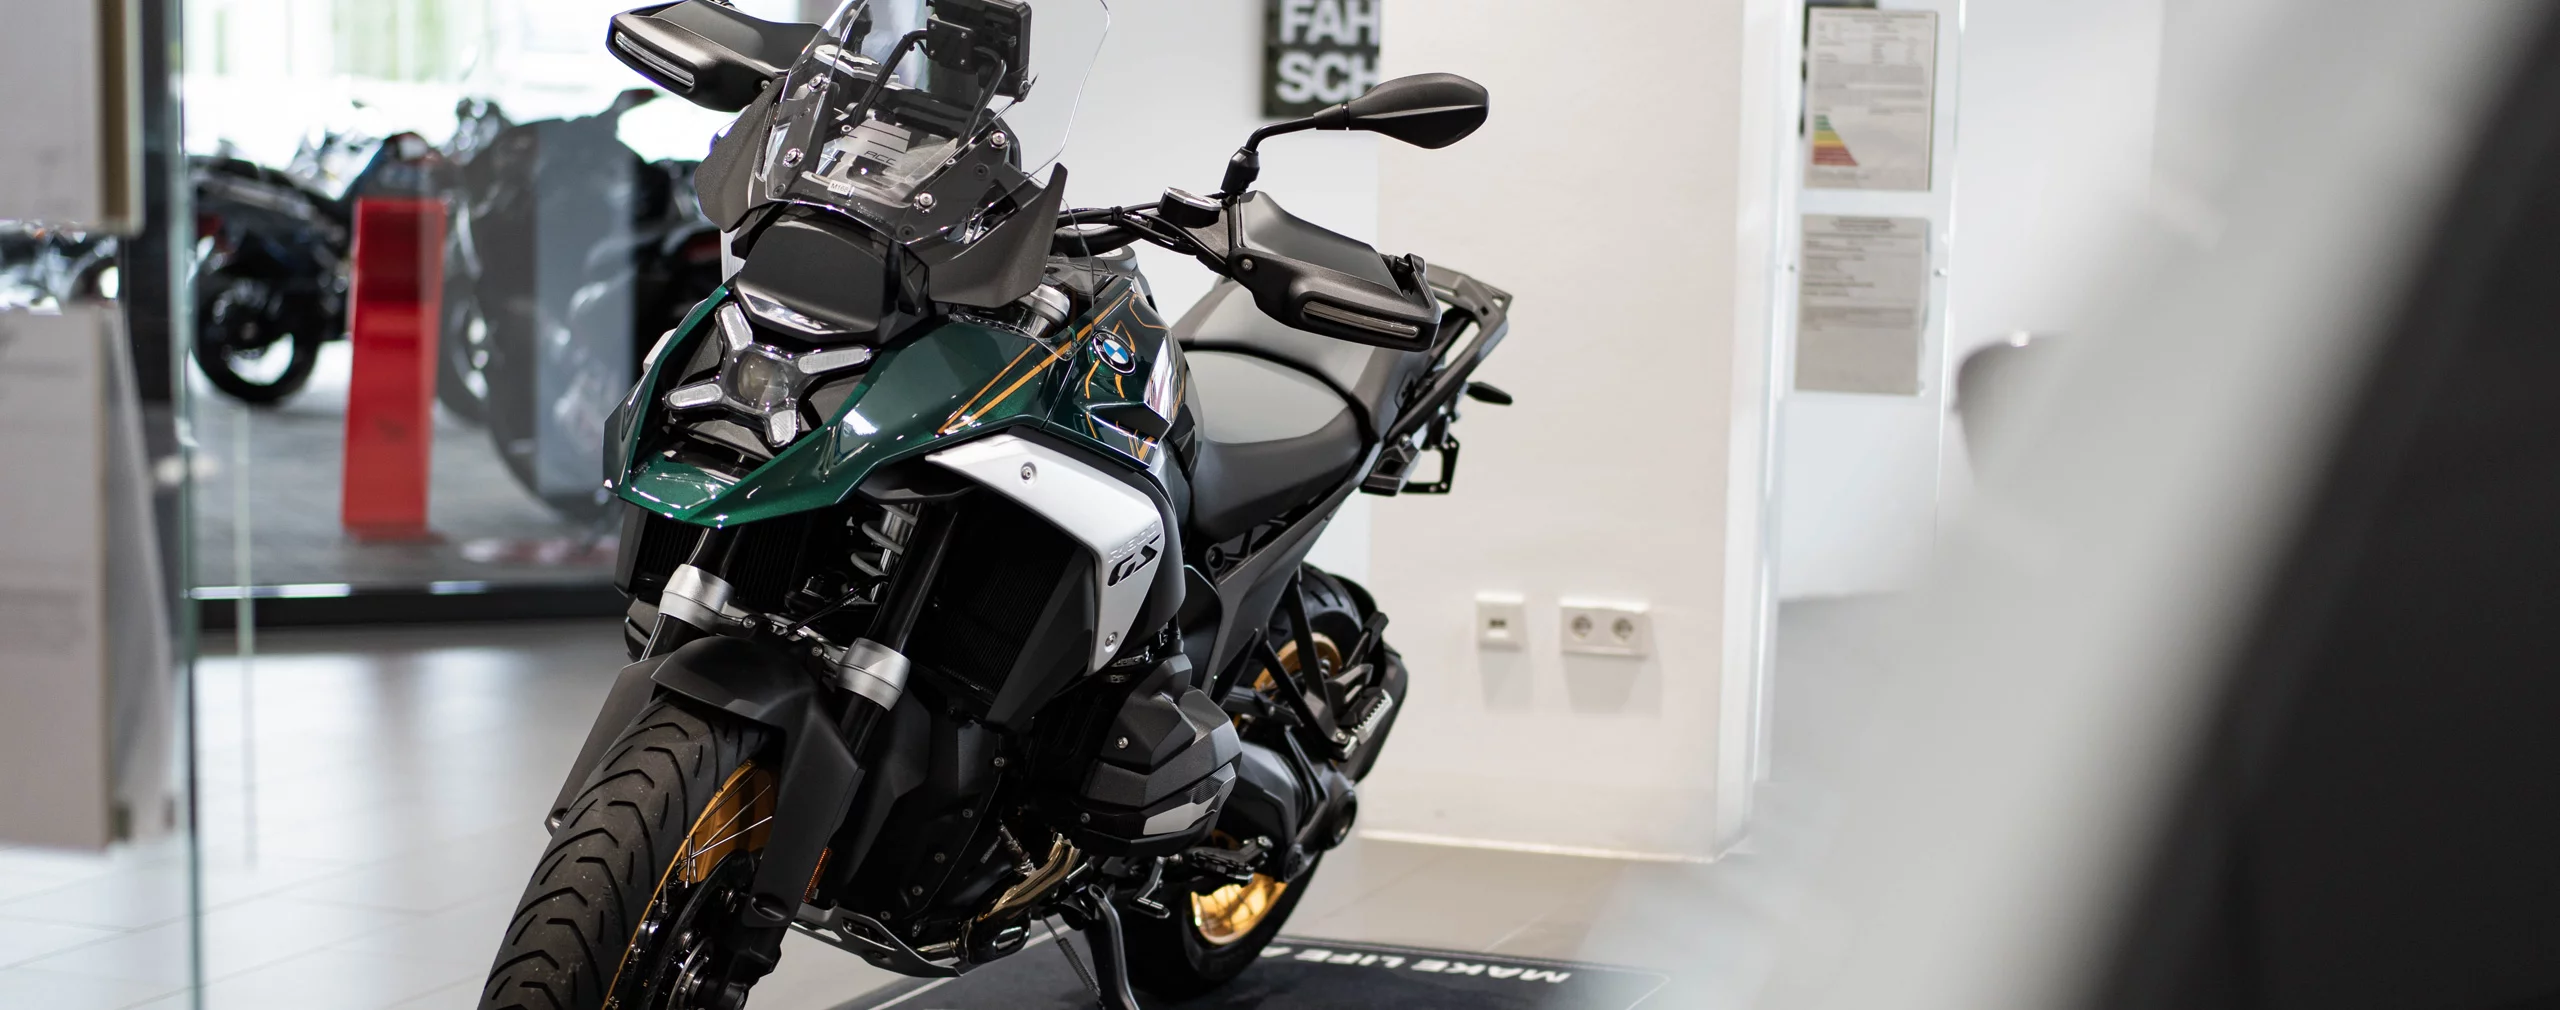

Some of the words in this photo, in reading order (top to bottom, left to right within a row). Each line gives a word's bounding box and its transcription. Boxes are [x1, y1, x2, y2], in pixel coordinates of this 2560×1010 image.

[864, 150, 897, 166] ACC
[1107, 533, 1161, 587] GS
[1294, 948, 1406, 969] LIFE
[1411, 958, 1572, 984] MAKE
